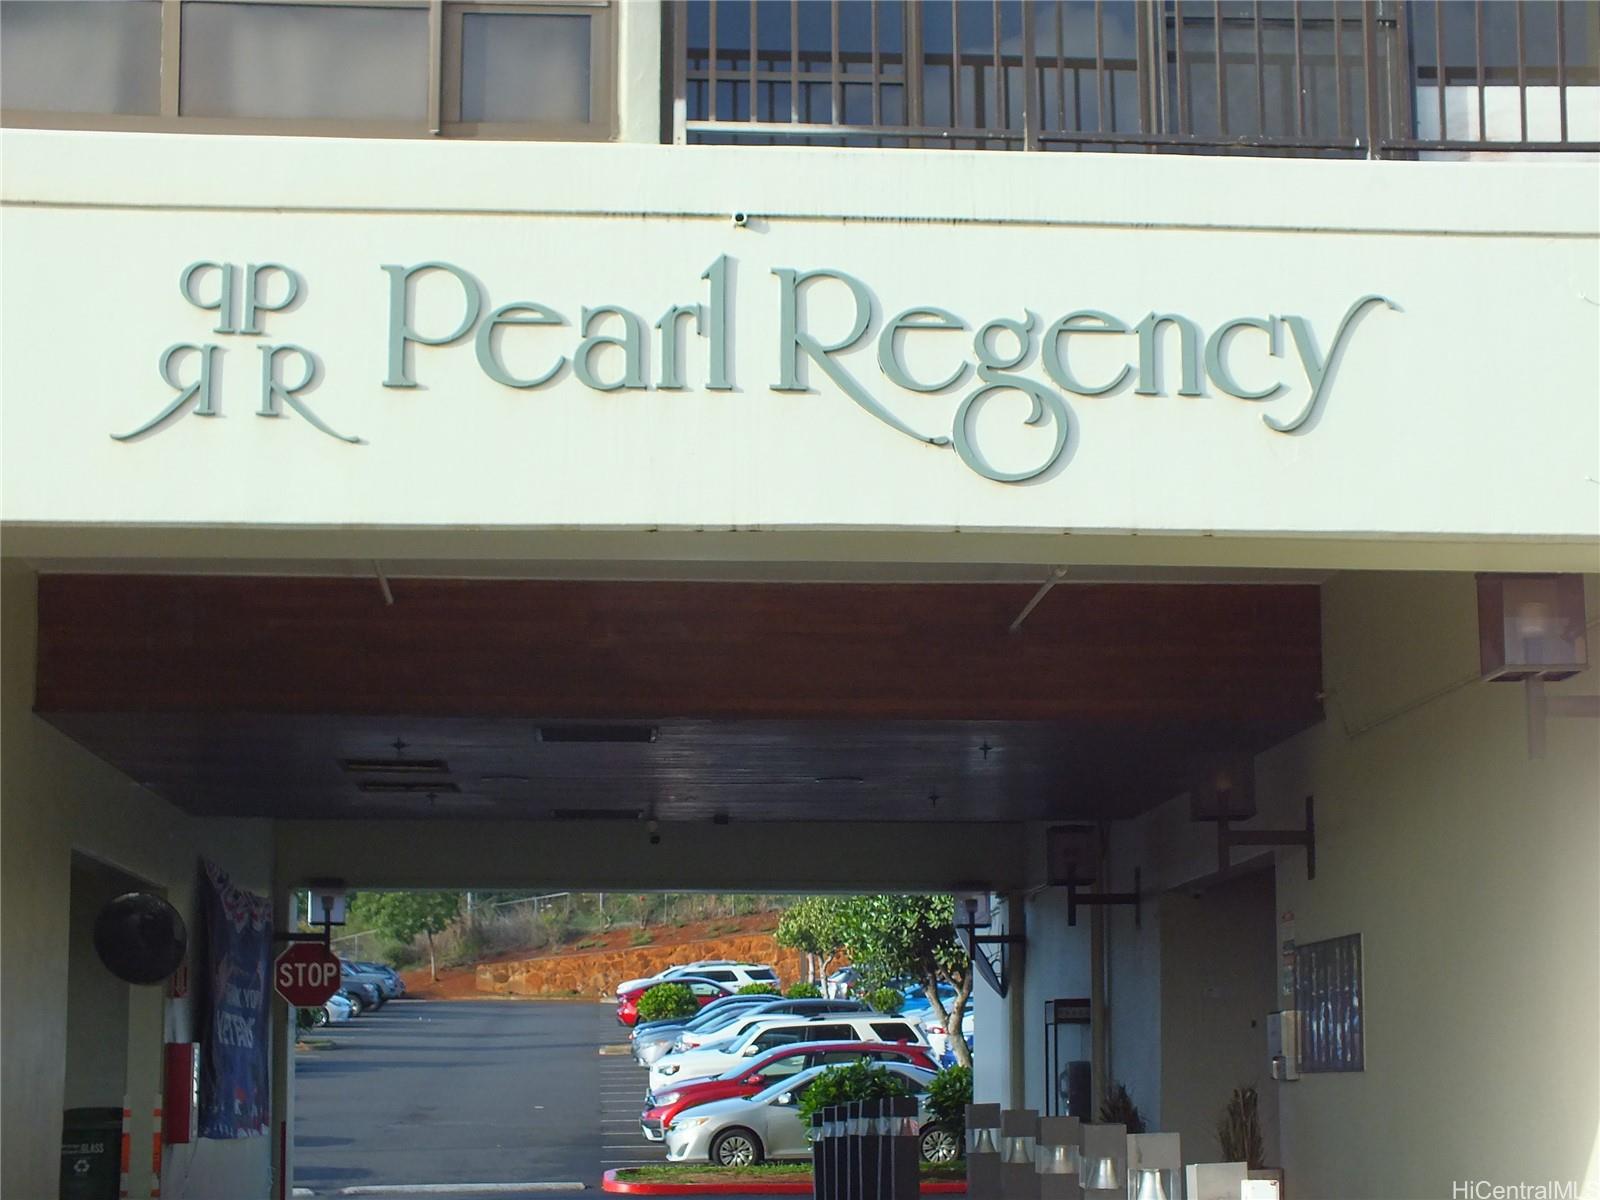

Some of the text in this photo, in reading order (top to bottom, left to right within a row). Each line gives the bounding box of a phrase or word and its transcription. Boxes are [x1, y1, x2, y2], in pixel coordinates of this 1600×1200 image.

[380, 253, 1402, 483] Pearl Regency
[279, 962, 338, 988] STOP
